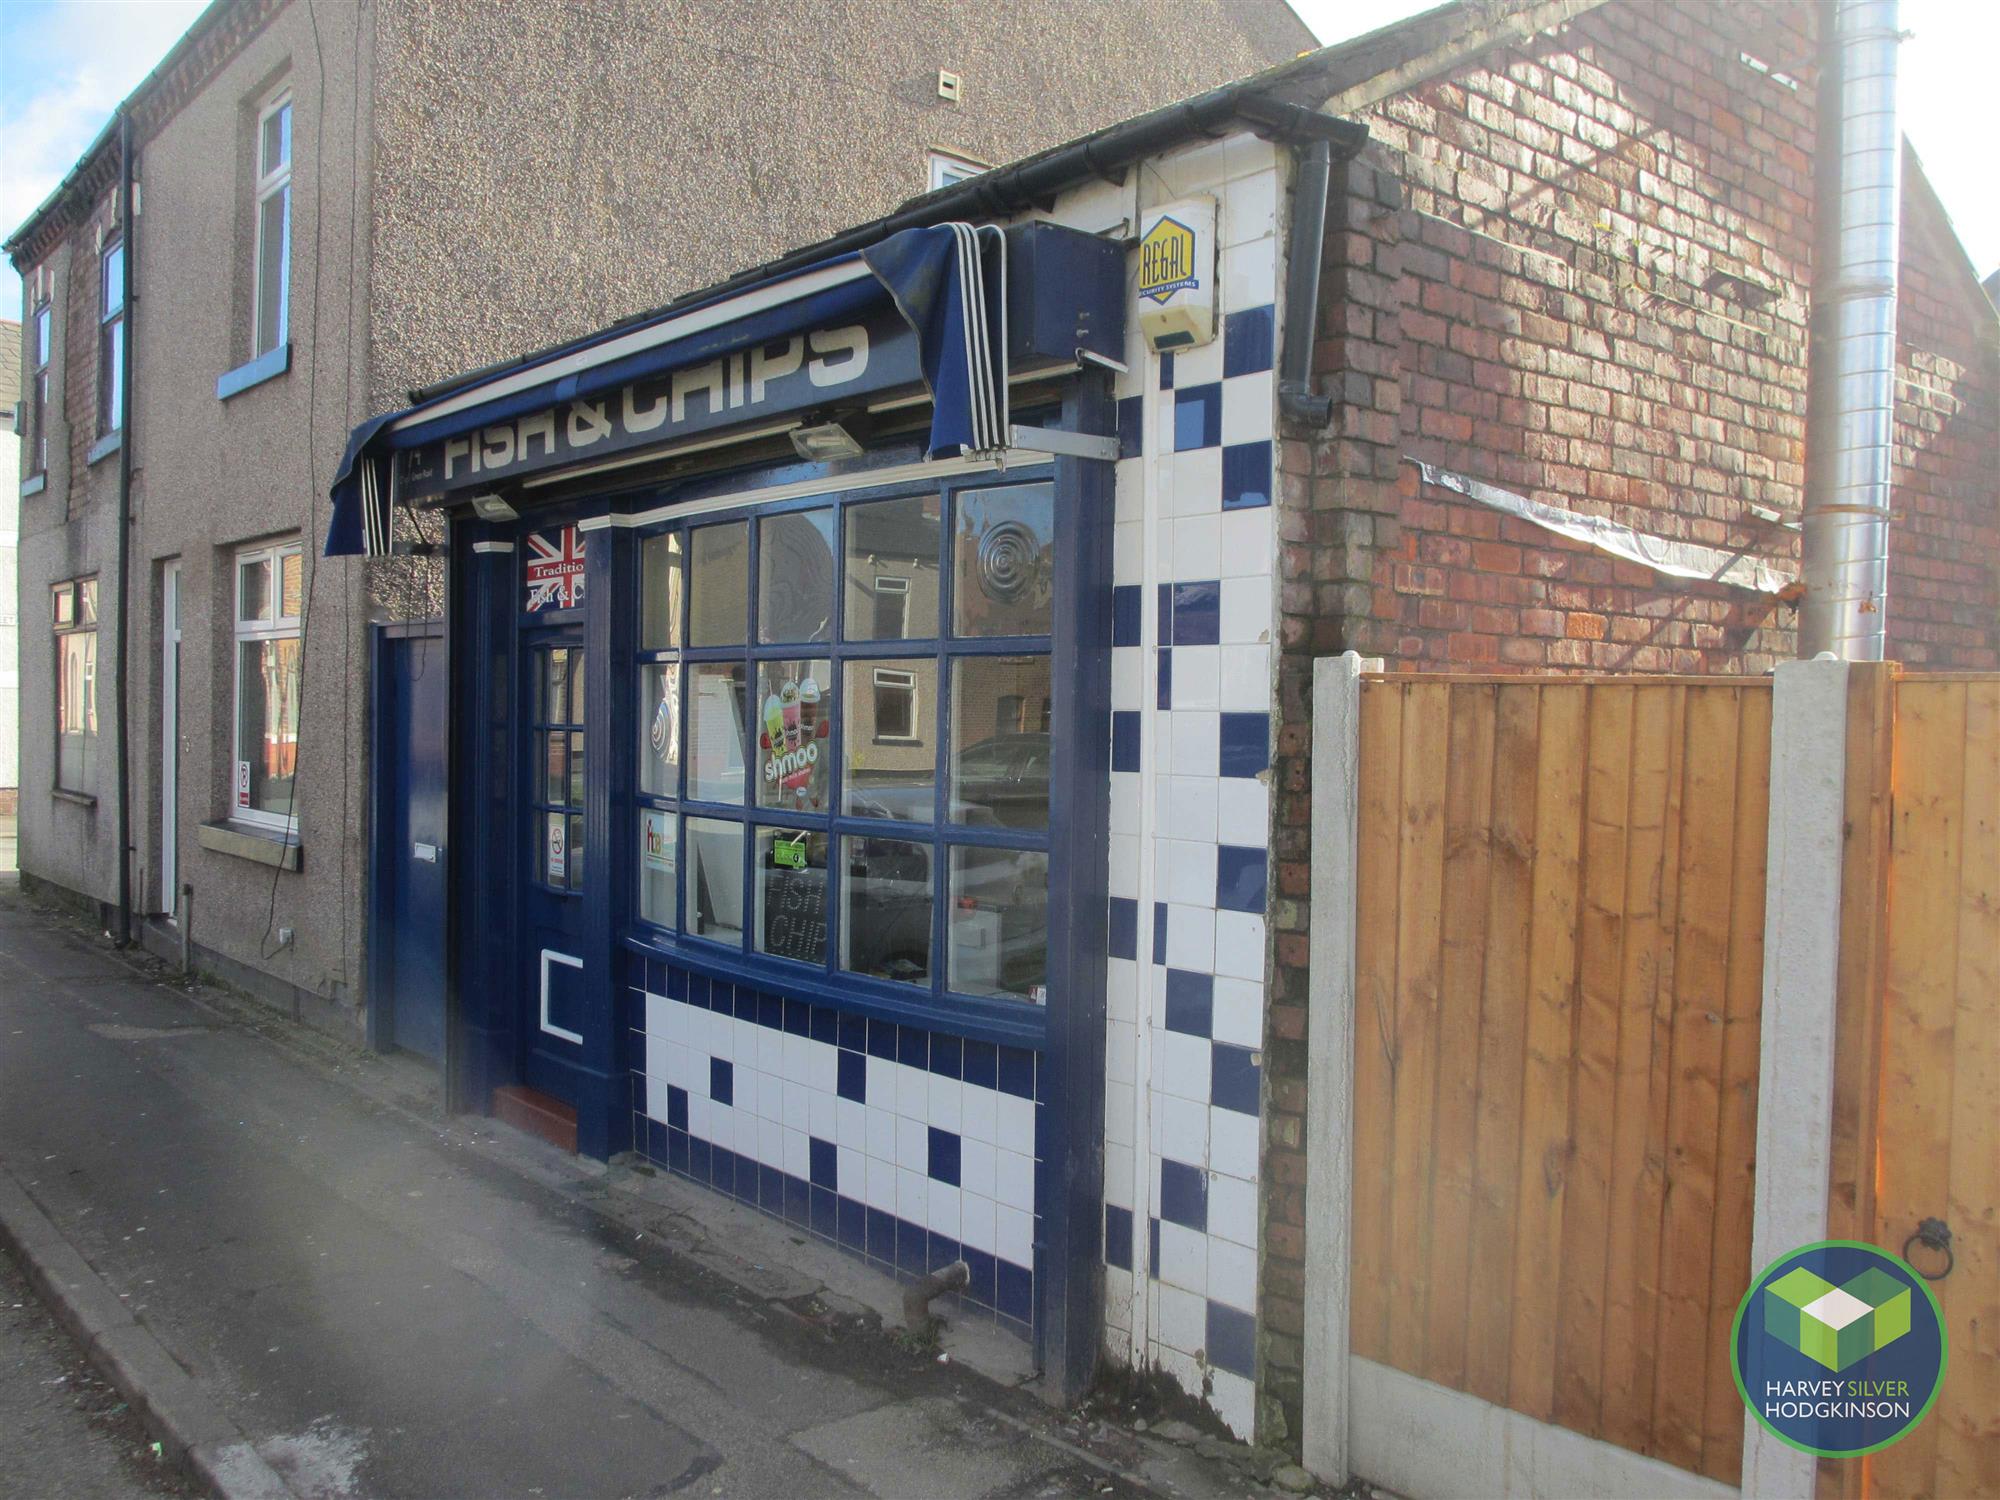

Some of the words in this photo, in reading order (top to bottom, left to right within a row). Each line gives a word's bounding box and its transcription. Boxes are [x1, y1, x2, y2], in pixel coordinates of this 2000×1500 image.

[1142, 234, 1187, 286] REGAL
[1166, 281, 1196, 290] SYSTEMS
[445, 409, 555, 480] FISH
[567, 400, 612, 448] &
[622, 324, 869, 434] CHIPS
[557, 585, 569, 601] &
[764, 743, 818, 782] shmoo
